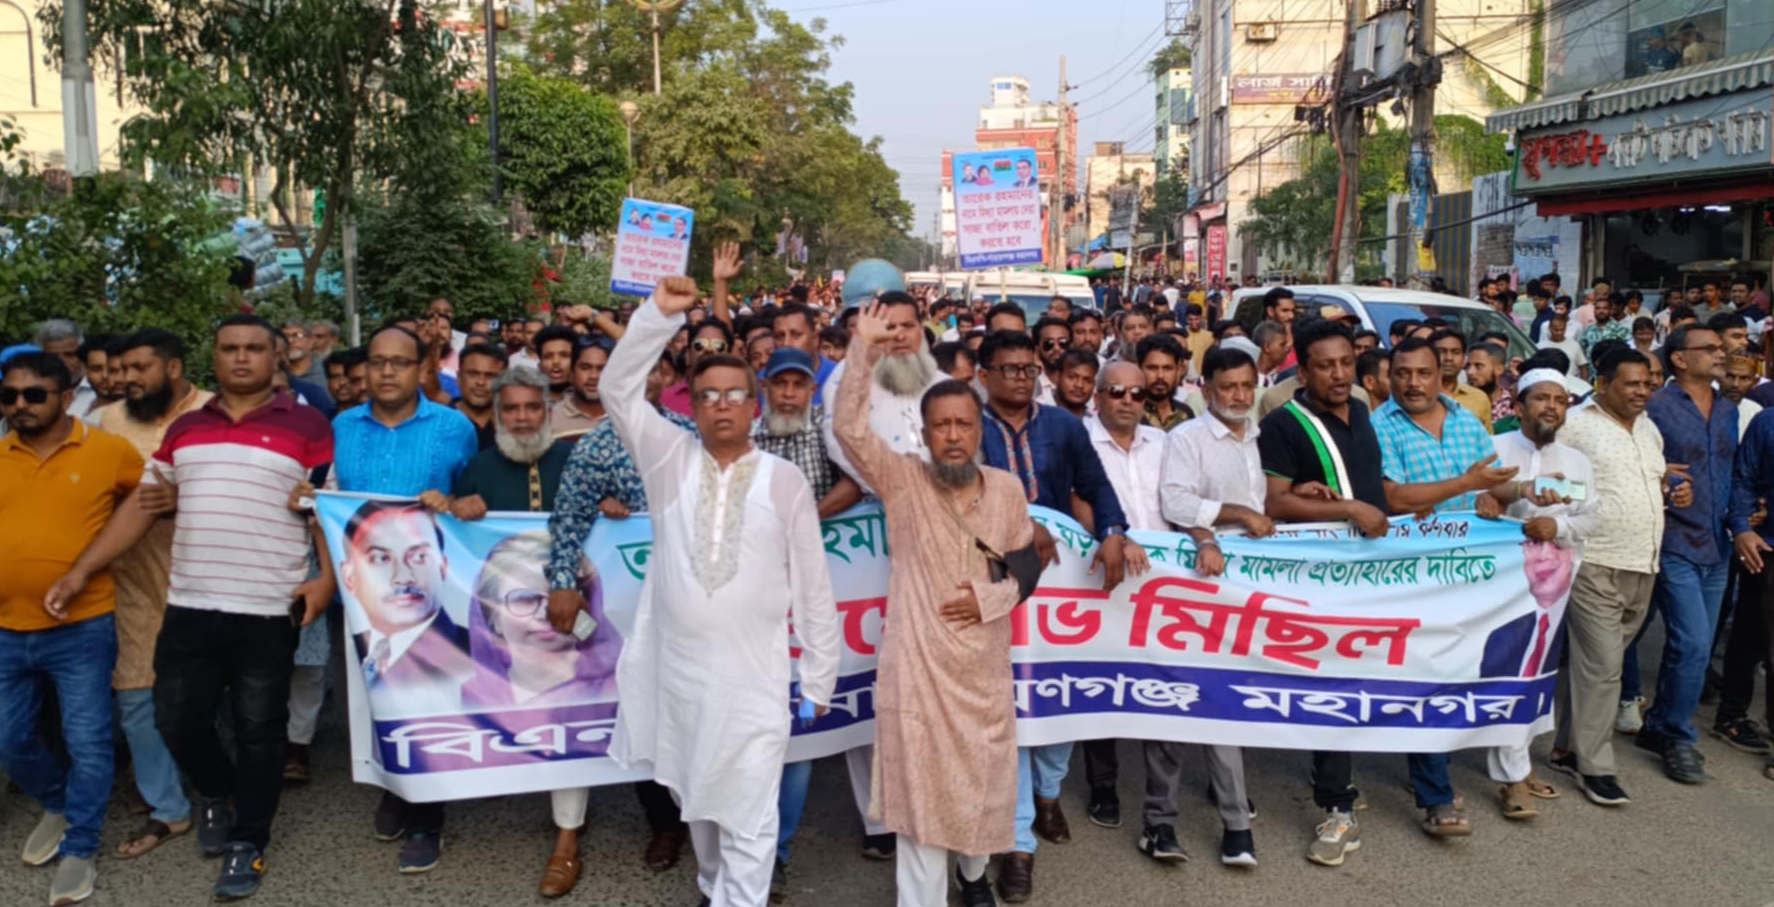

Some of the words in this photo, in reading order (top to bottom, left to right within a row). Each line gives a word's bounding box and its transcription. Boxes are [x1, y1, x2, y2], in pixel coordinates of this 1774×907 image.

[1239, 554, 1309, 584] মামলা
[1308, 556, 1421, 587] প্রত্যাহারের
[1426, 547, 1496, 585] দাবিতে
[1129, 576, 1421, 670] মিছিল
[1228, 685, 1526, 724] মহানগর
